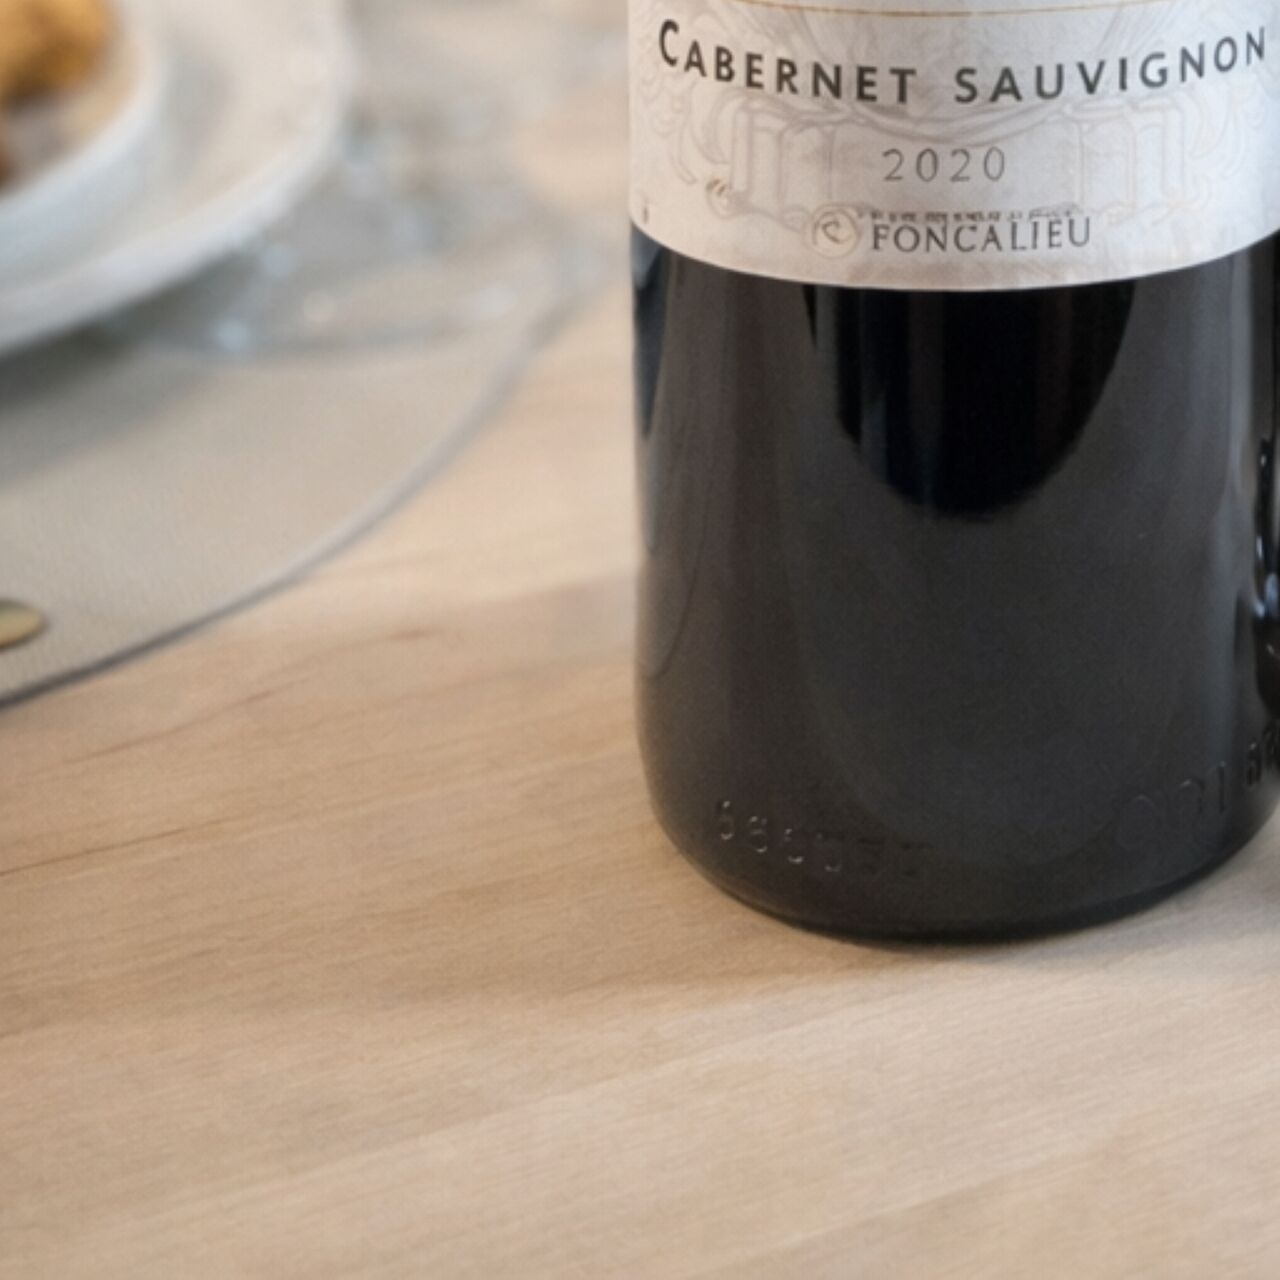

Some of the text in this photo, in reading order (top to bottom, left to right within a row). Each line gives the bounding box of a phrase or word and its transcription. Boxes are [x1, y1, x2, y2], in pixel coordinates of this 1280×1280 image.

[657, 18, 1268, 105] CABERNET SAUVIGNON
[881, 146, 1007, 183] 2020
[870, 217, 1091, 253] FONCALIEU
